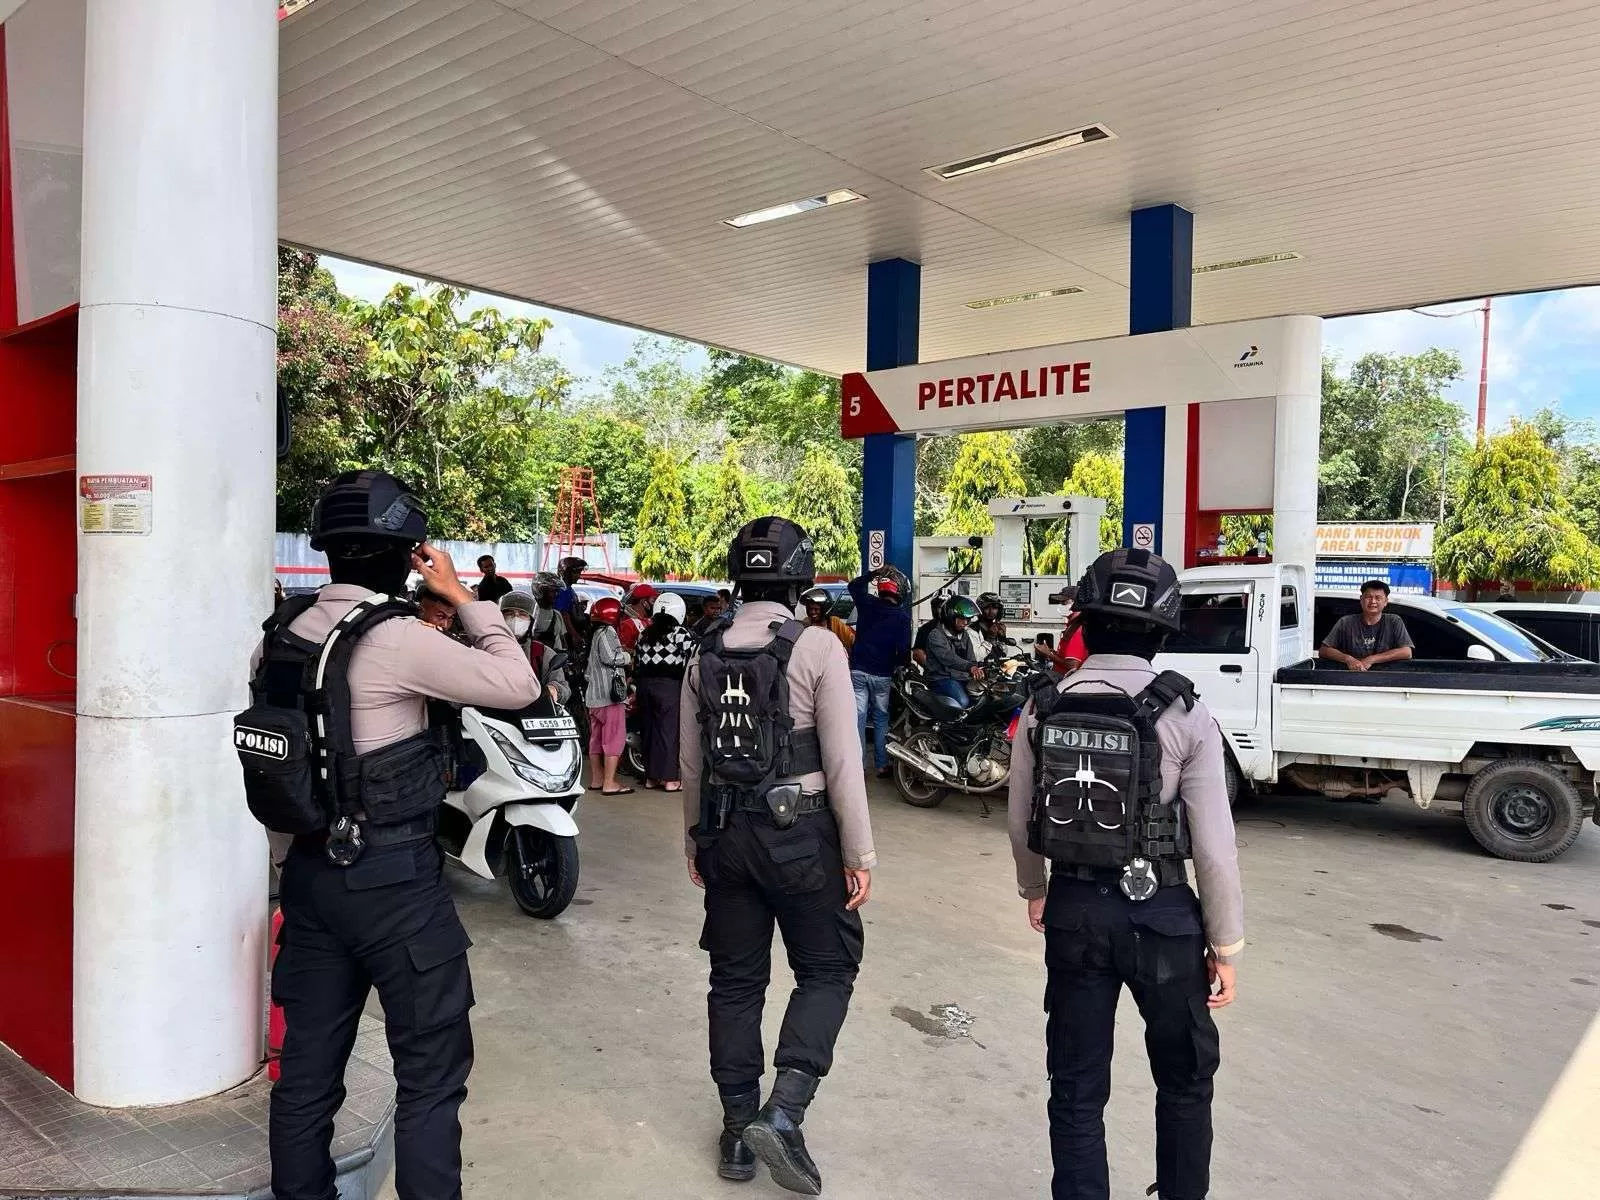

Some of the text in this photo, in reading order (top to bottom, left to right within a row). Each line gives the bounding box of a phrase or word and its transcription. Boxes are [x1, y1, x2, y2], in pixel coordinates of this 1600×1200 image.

[1233, 360, 1264, 369] PERTAMINA
[918, 362, 1091, 410] PERTALITE
[849, 396, 861, 417] 5
[1316, 527, 1422, 540] RANG MEROKOK
[1320, 540, 1403, 553] AREAL SPBU
[1315, 566, 1343, 574] ENJAGA
[524, 720, 535, 729] KT
[563, 718, 572, 727] PP
[235, 730, 284, 755] POLISI
[1046, 728, 1129, 751] POLISI
